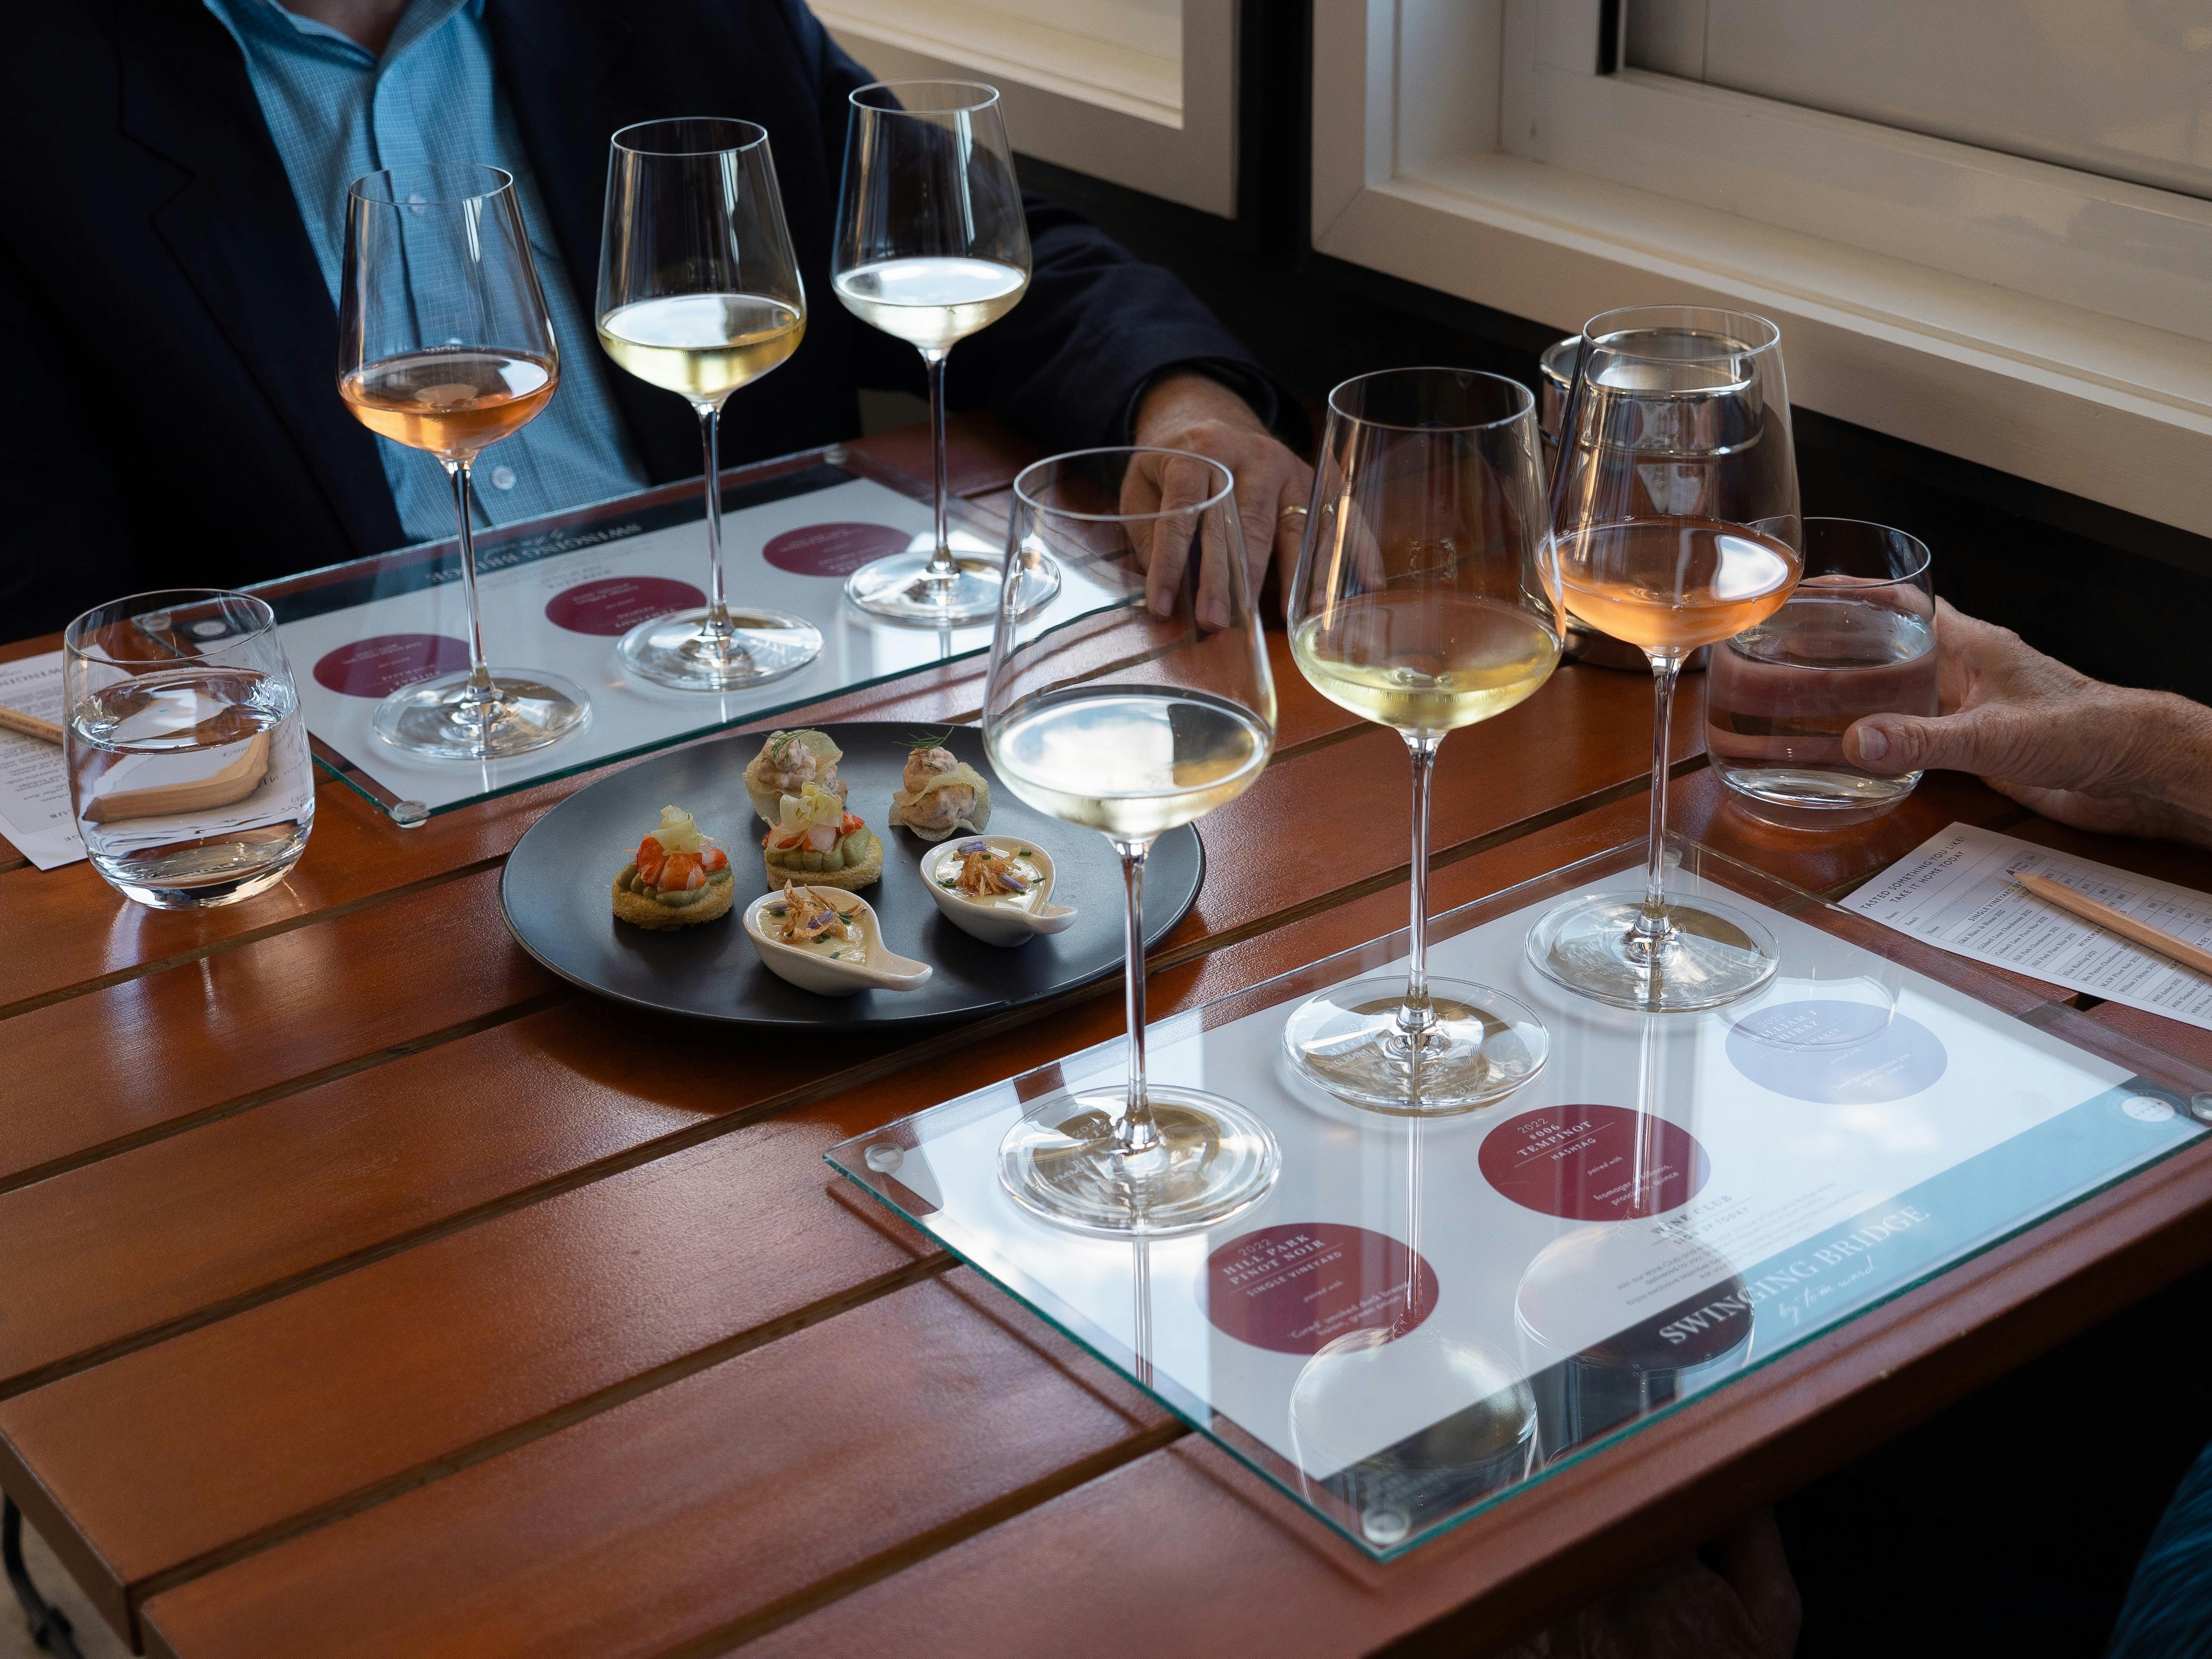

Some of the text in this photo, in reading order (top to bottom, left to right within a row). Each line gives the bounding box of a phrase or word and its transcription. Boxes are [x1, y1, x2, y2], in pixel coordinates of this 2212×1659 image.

[426, 553, 519, 583] BRIGE
[1860, 890, 1890, 910] TASTED
[1889, 860, 1932, 890] SOMETHING
[1929, 850, 1947, 863] YOU
[1890, 890, 1912, 903] TAKE
[1919, 868, 1943, 884] HOME
[1885, 910, 1900, 921] Name:
[1968, 906, 1990, 922] SINGLE
[1988, 888, 2014, 908] VINEYARD
[1905, 916, 1920, 926] Email:
[1926, 926, 1940, 934] Name
[1968, 928, 1980, 937] Blanc
[1984, 916, 1997, 926] Blancs
[1977, 938, 1994, 950] Caldwell
[2002, 917, 2024, 932] Chardonnay
[1995, 944, 2012, 956] Caldwell
[2019, 929, 2031, 938] Pinot
[2029, 923, 2039, 931] Noir
[2012, 953, 2023, 961] Hill
[2021, 946, 2032, 955] Park
[2031, 931, 2052, 948] Chardonnay
[2039, 952, 2050, 960] Park
[2048, 944, 2060, 953] Pinot
[2072, 955, 2090, 970] Riesling
[2086, 950, 2097, 959] 2023
[2101, 949, 2124, 966] Chardonnay
[2113, 968, 2125, 979] Pinot
[2122, 961, 2133, 971] Noir
[2119, 982, 2135, 992] William
[2137, 970, 2150, 980] Shiraz
[2147, 962, 2158, 971] 2022
[1748, 1015, 1807, 1042] WILLIAM
[1758, 1014, 1785, 1027] 2022
[1772, 1020, 1819, 1043] SHIRAZ
[1787, 1027, 1841, 1054] WINEMAKER
[1830, 1053, 1849, 1065] paired
[1517, 1118, 1548, 1134] 2022
[1529, 1124, 1560, 1140] #006
[1517, 1121, 1592, 1156] TEMPINOT
[1550, 1138, 1596, 1160] HASHTAG
[1587, 1156, 1622, 1175] paired with
[1653, 1171, 1679, 1186] quince
[1593, 1182, 1632, 1201] fromager
[1651, 1195, 1731, 1235] WINE CLUB
[1716, 1207, 1749, 1224] TODAY
[1222, 1235, 1310, 1275] HILL PARK
[1238, 1239, 1271, 1256] 2022
[1230, 1240, 1325, 1285] PINOT NOIR
[1661, 1255, 1680, 1267] Club
[1247, 1252, 1341, 1296] SINGLE VINEYARD
[1659, 1260, 1819, 1344] SWINGING
[1813, 1206, 1930, 1265] BRIDGE
[1779, 1303, 1799, 1325] by
